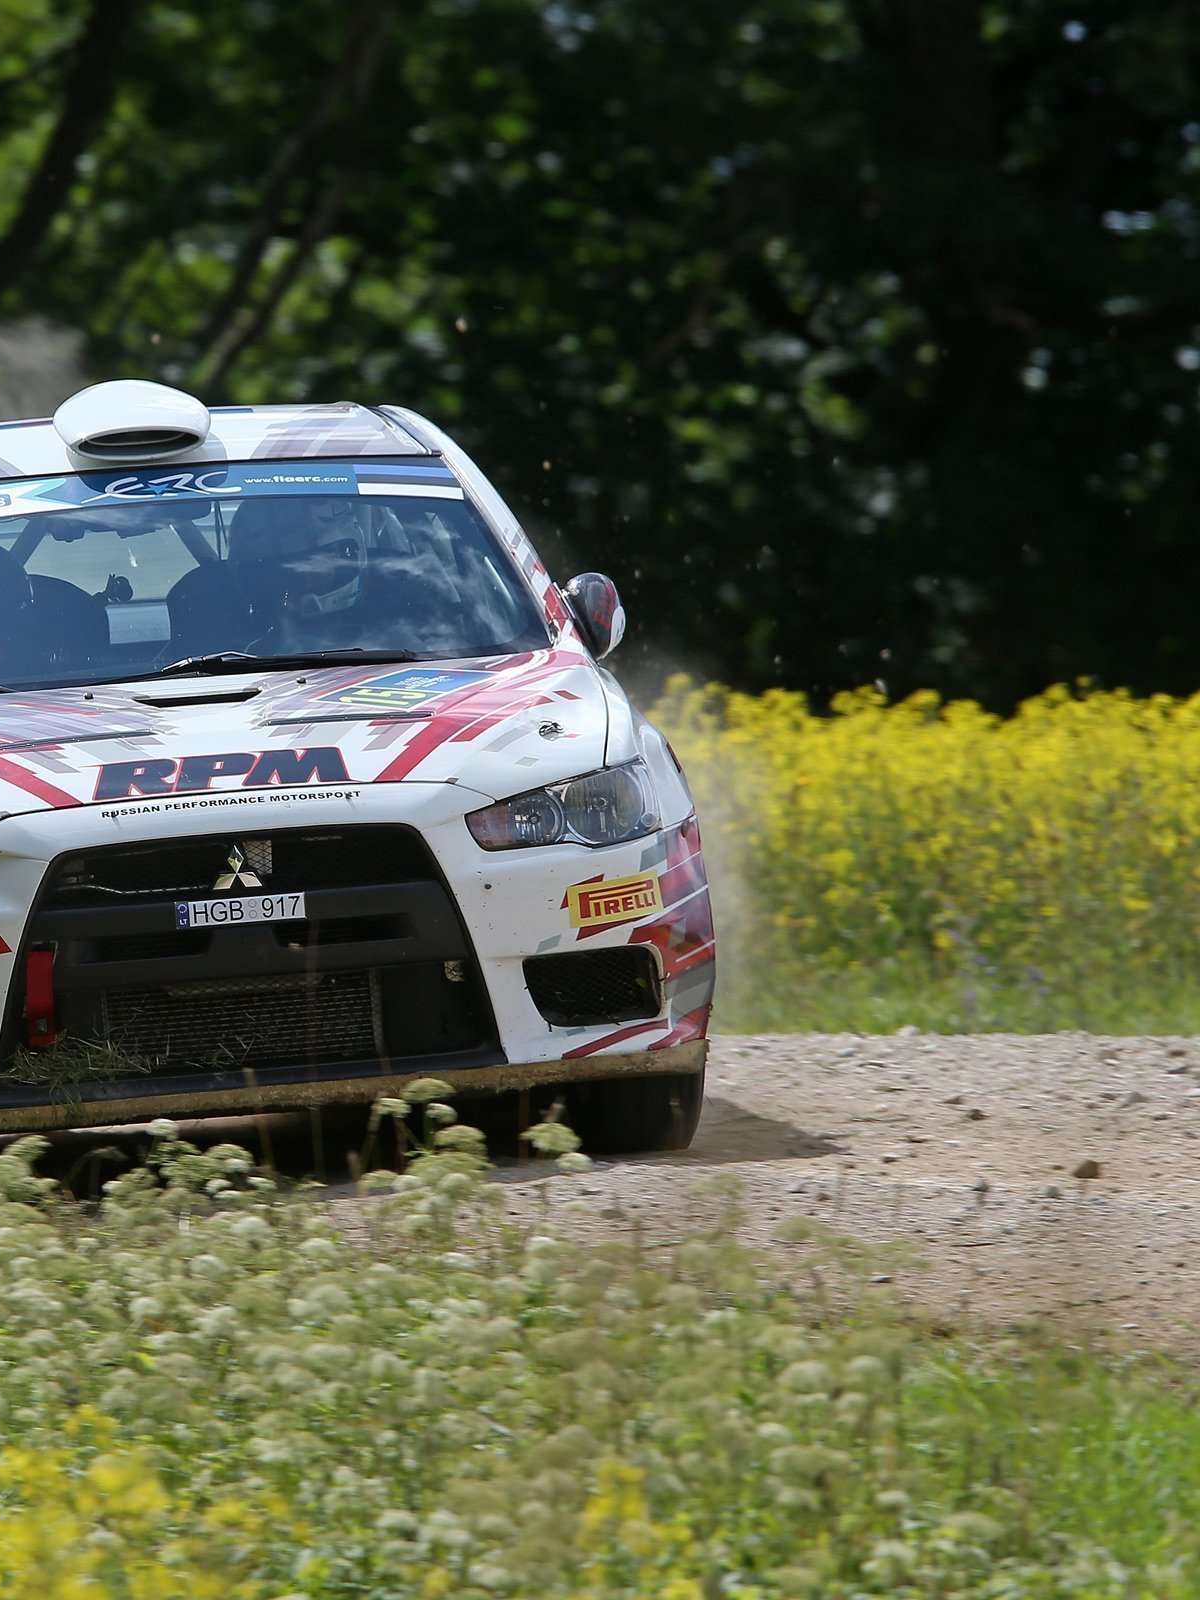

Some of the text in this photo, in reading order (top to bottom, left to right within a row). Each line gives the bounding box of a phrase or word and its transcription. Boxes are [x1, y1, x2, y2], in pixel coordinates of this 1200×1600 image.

[81, 470, 242, 503] ERC
[244, 475, 348, 484] www.fiaerc.com
[93, 746, 356, 801] RPM
[101, 790, 362, 819] RUSSIAN PERFORMANCE MOTORSPORT
[192, 895, 301, 924] HGB 917
[578, 879, 657, 919] PIRELLI
[179, 918, 188, 926] LT
